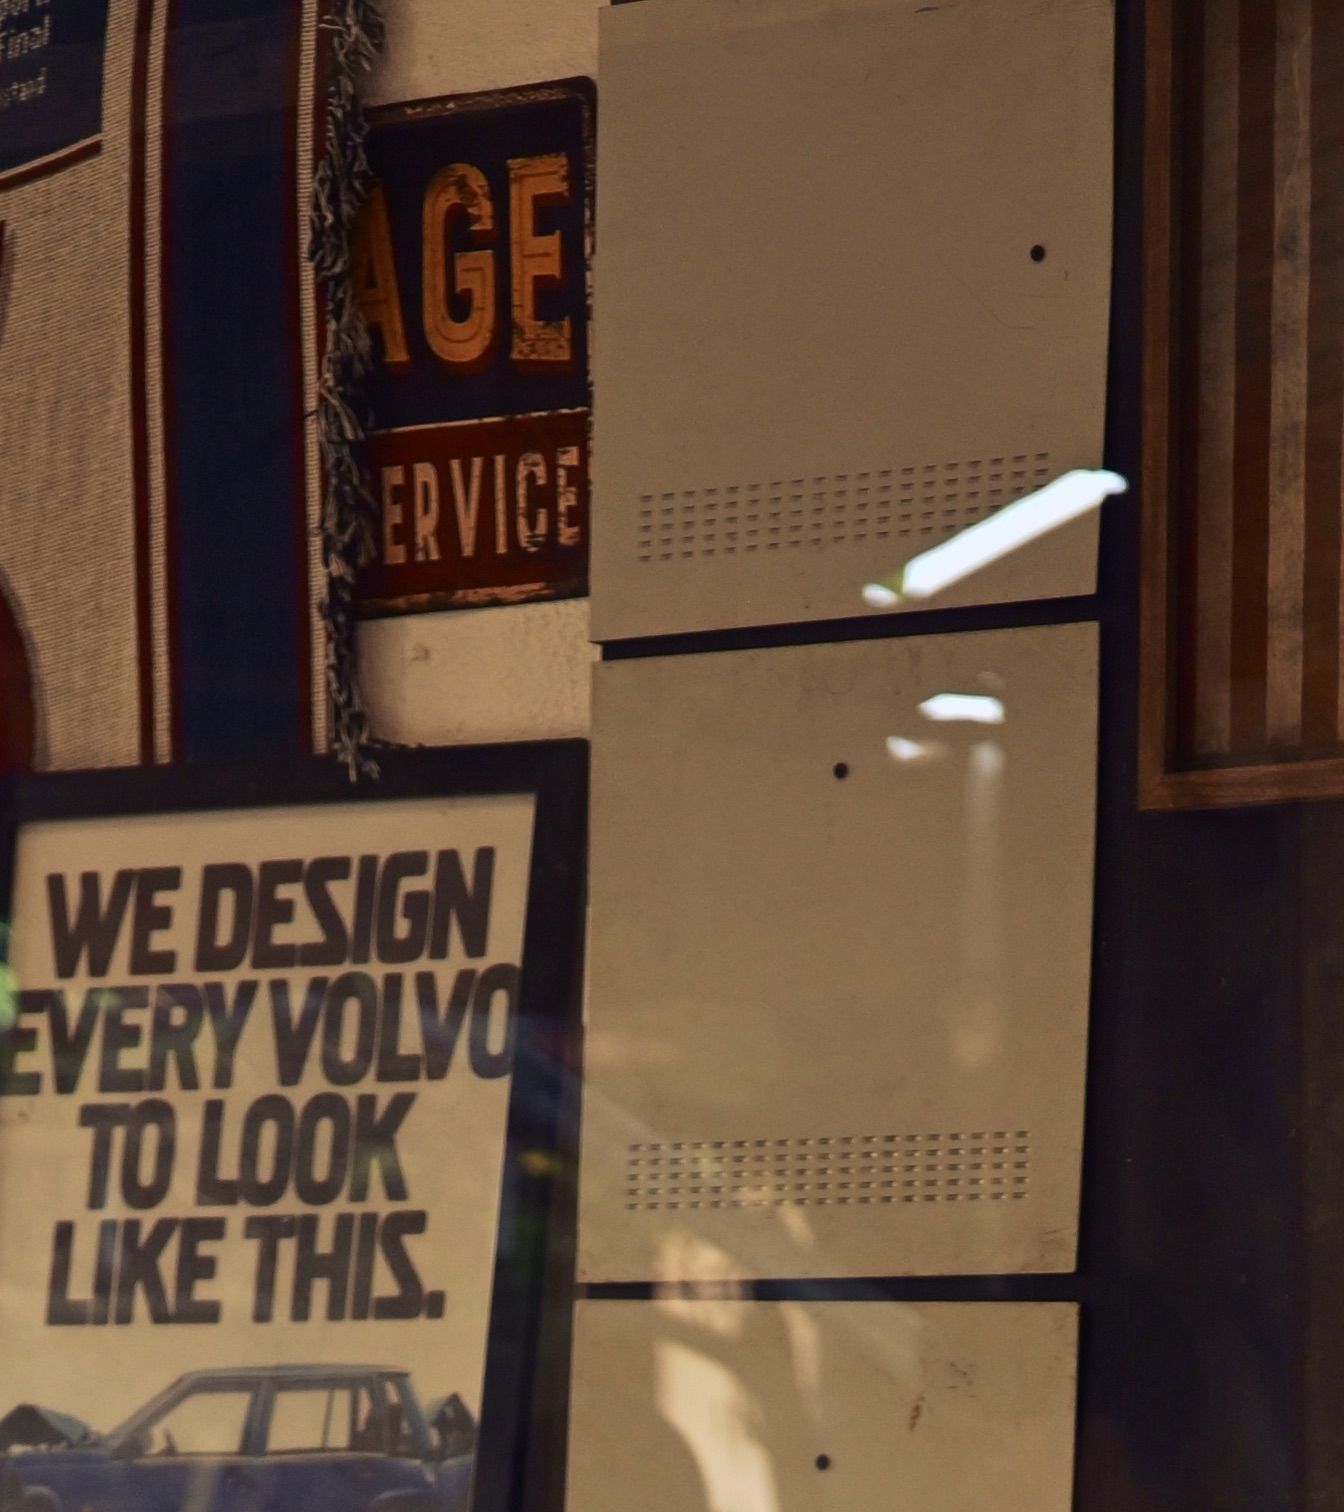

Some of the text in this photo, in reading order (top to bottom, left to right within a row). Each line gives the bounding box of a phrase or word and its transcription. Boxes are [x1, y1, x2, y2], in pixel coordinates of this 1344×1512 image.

[377, 444, 584, 568] ERVICE
[45, 846, 495, 981] WE DESIGN
[6, 963, 521, 1097] EVERY VOLVO
[79, 1099, 177, 1211] TO
[196, 1091, 418, 1207] LOOK
[46, 1210, 447, 1326] LIKE THIS.
